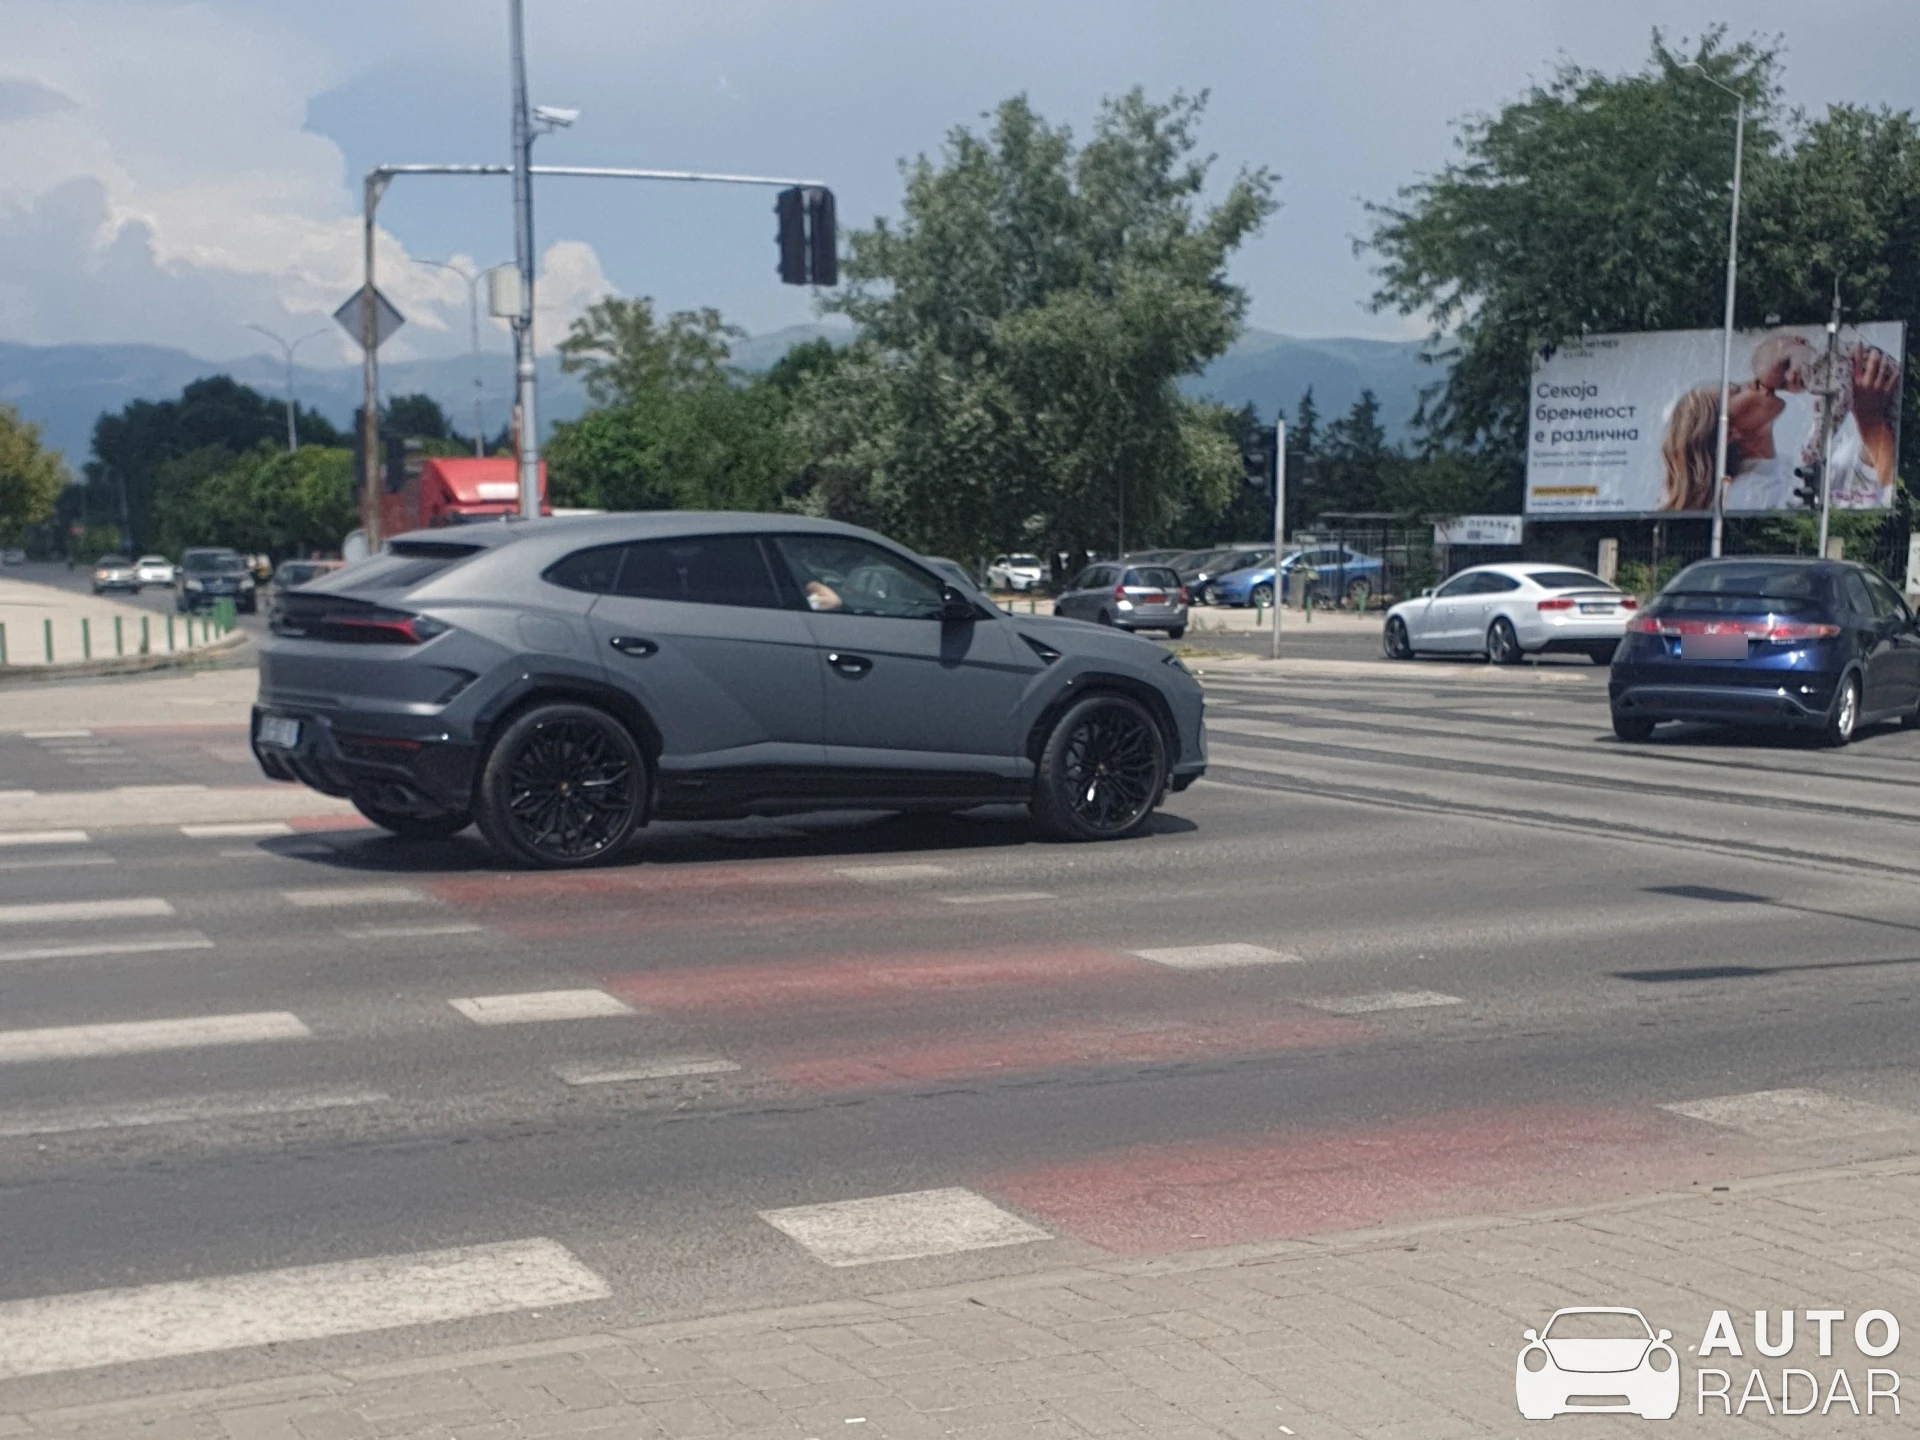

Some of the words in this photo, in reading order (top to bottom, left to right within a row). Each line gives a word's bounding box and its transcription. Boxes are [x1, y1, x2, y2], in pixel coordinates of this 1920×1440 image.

[1536, 380, 1598, 401] Секоја
[1535, 403, 1637, 424] бременост
[1534, 430, 1545, 443] е
[1551, 428, 1639, 446] различна
